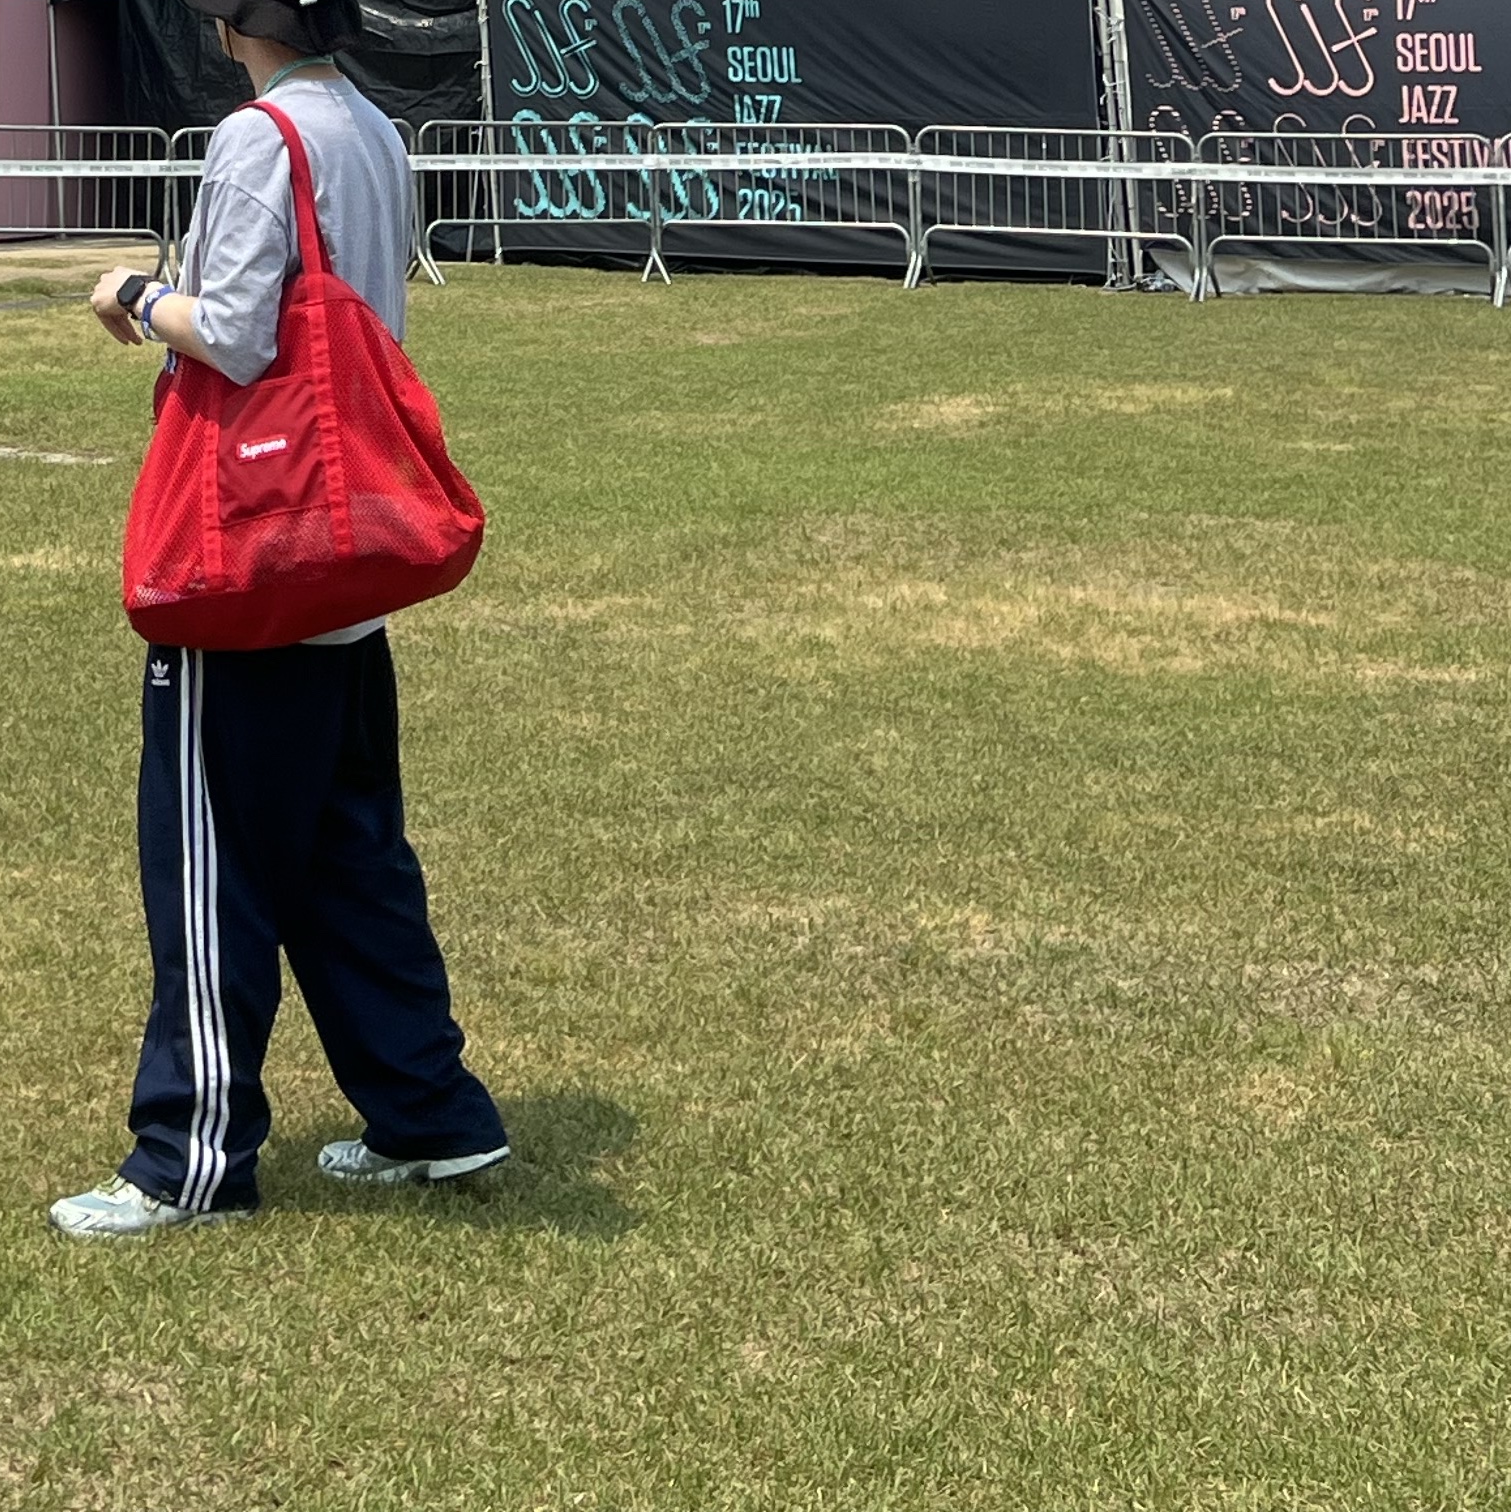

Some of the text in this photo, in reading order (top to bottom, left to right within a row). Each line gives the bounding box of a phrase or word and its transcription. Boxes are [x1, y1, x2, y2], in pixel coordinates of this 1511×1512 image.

[727, 45, 803, 84] SEOUL
[1395, 32, 1483, 73] SEOUL
[1397, 85, 1459, 125] JAZZ
[738, 188, 803, 221] 2025
[1405, 190, 1479, 230] 2025
